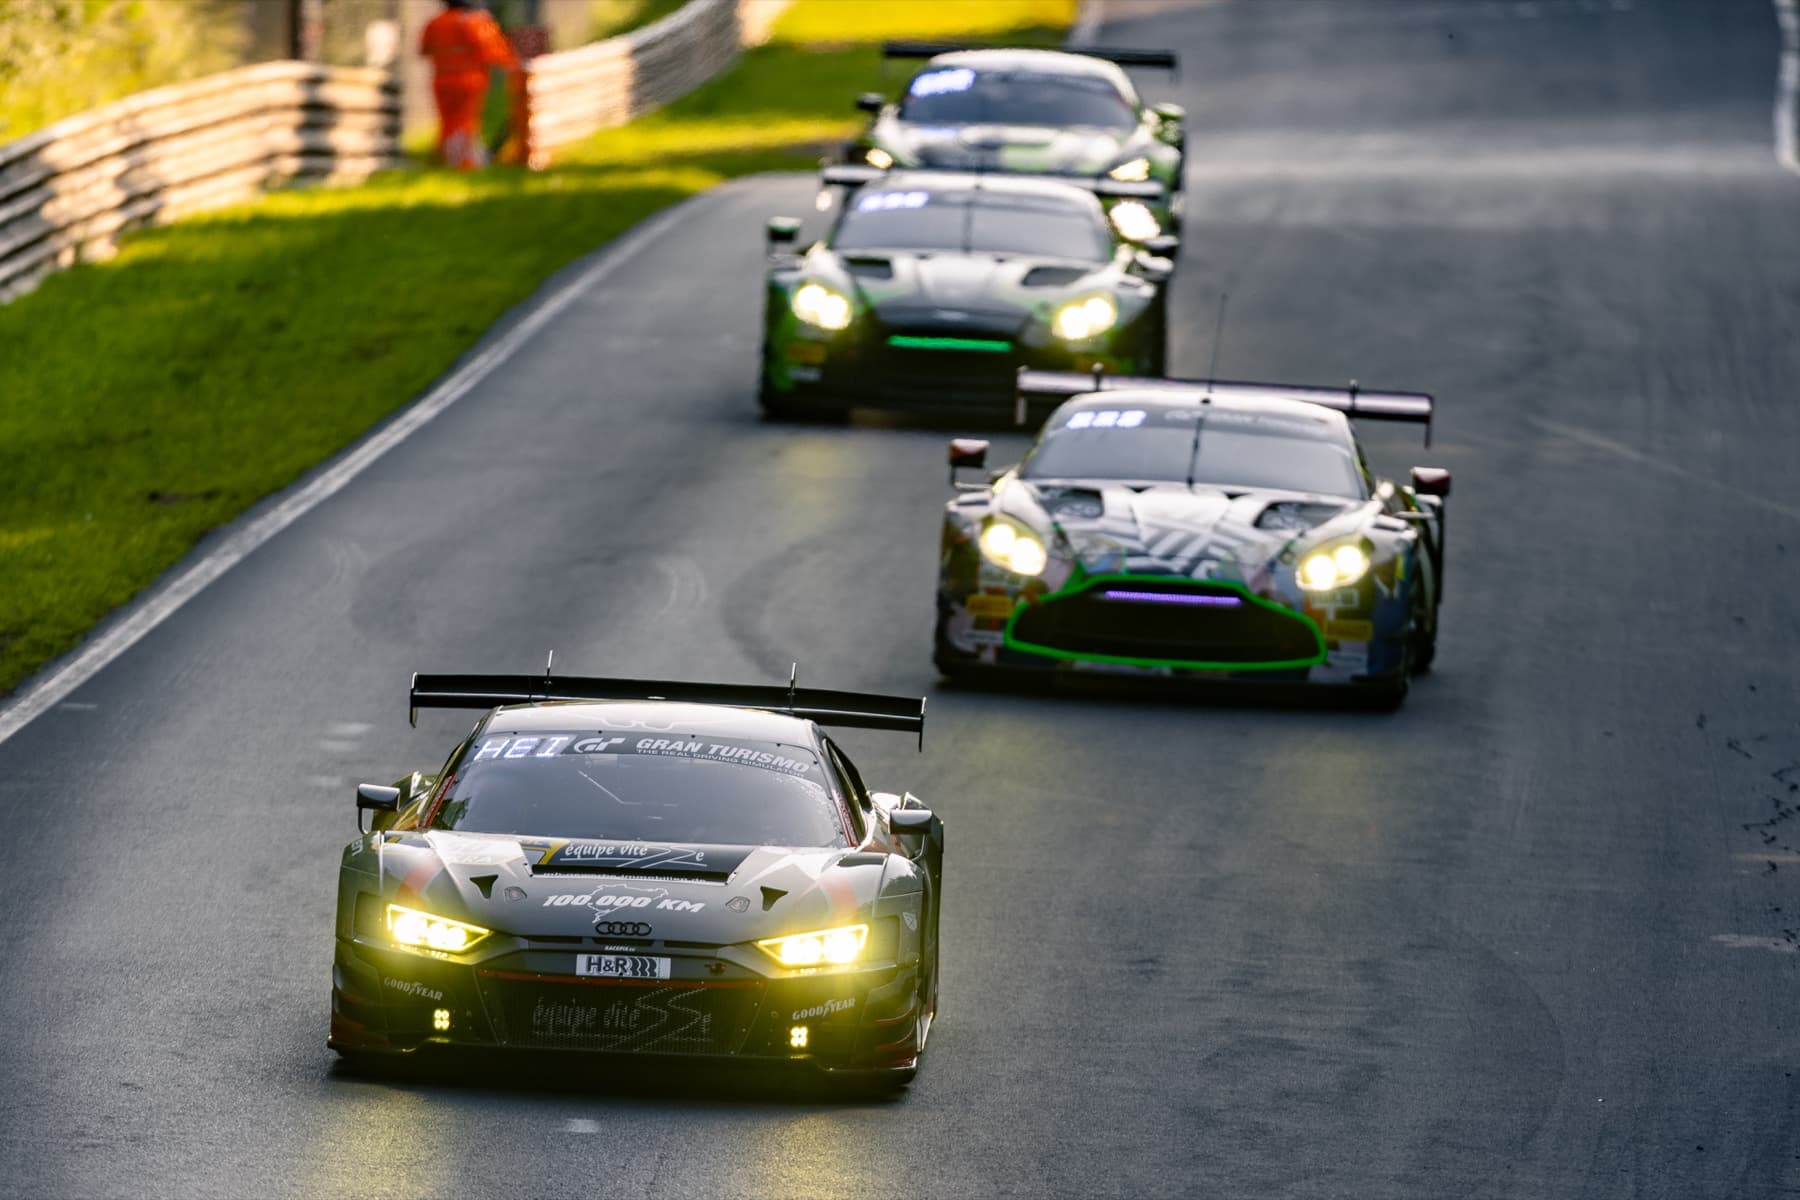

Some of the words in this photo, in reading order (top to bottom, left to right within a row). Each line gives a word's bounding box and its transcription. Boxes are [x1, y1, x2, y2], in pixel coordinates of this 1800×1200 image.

[636, 738, 703, 753] GRAN
[708, 744, 810, 773] TURISMO
[661, 750, 689, 758] REAL
[693, 753, 738, 764] DRIVING
[656, 899, 707, 913] KM
[586, 956, 628, 973] H&R
[383, 976, 443, 1001] GOODYEAR
[791, 998, 856, 1021] GOODYEAR
